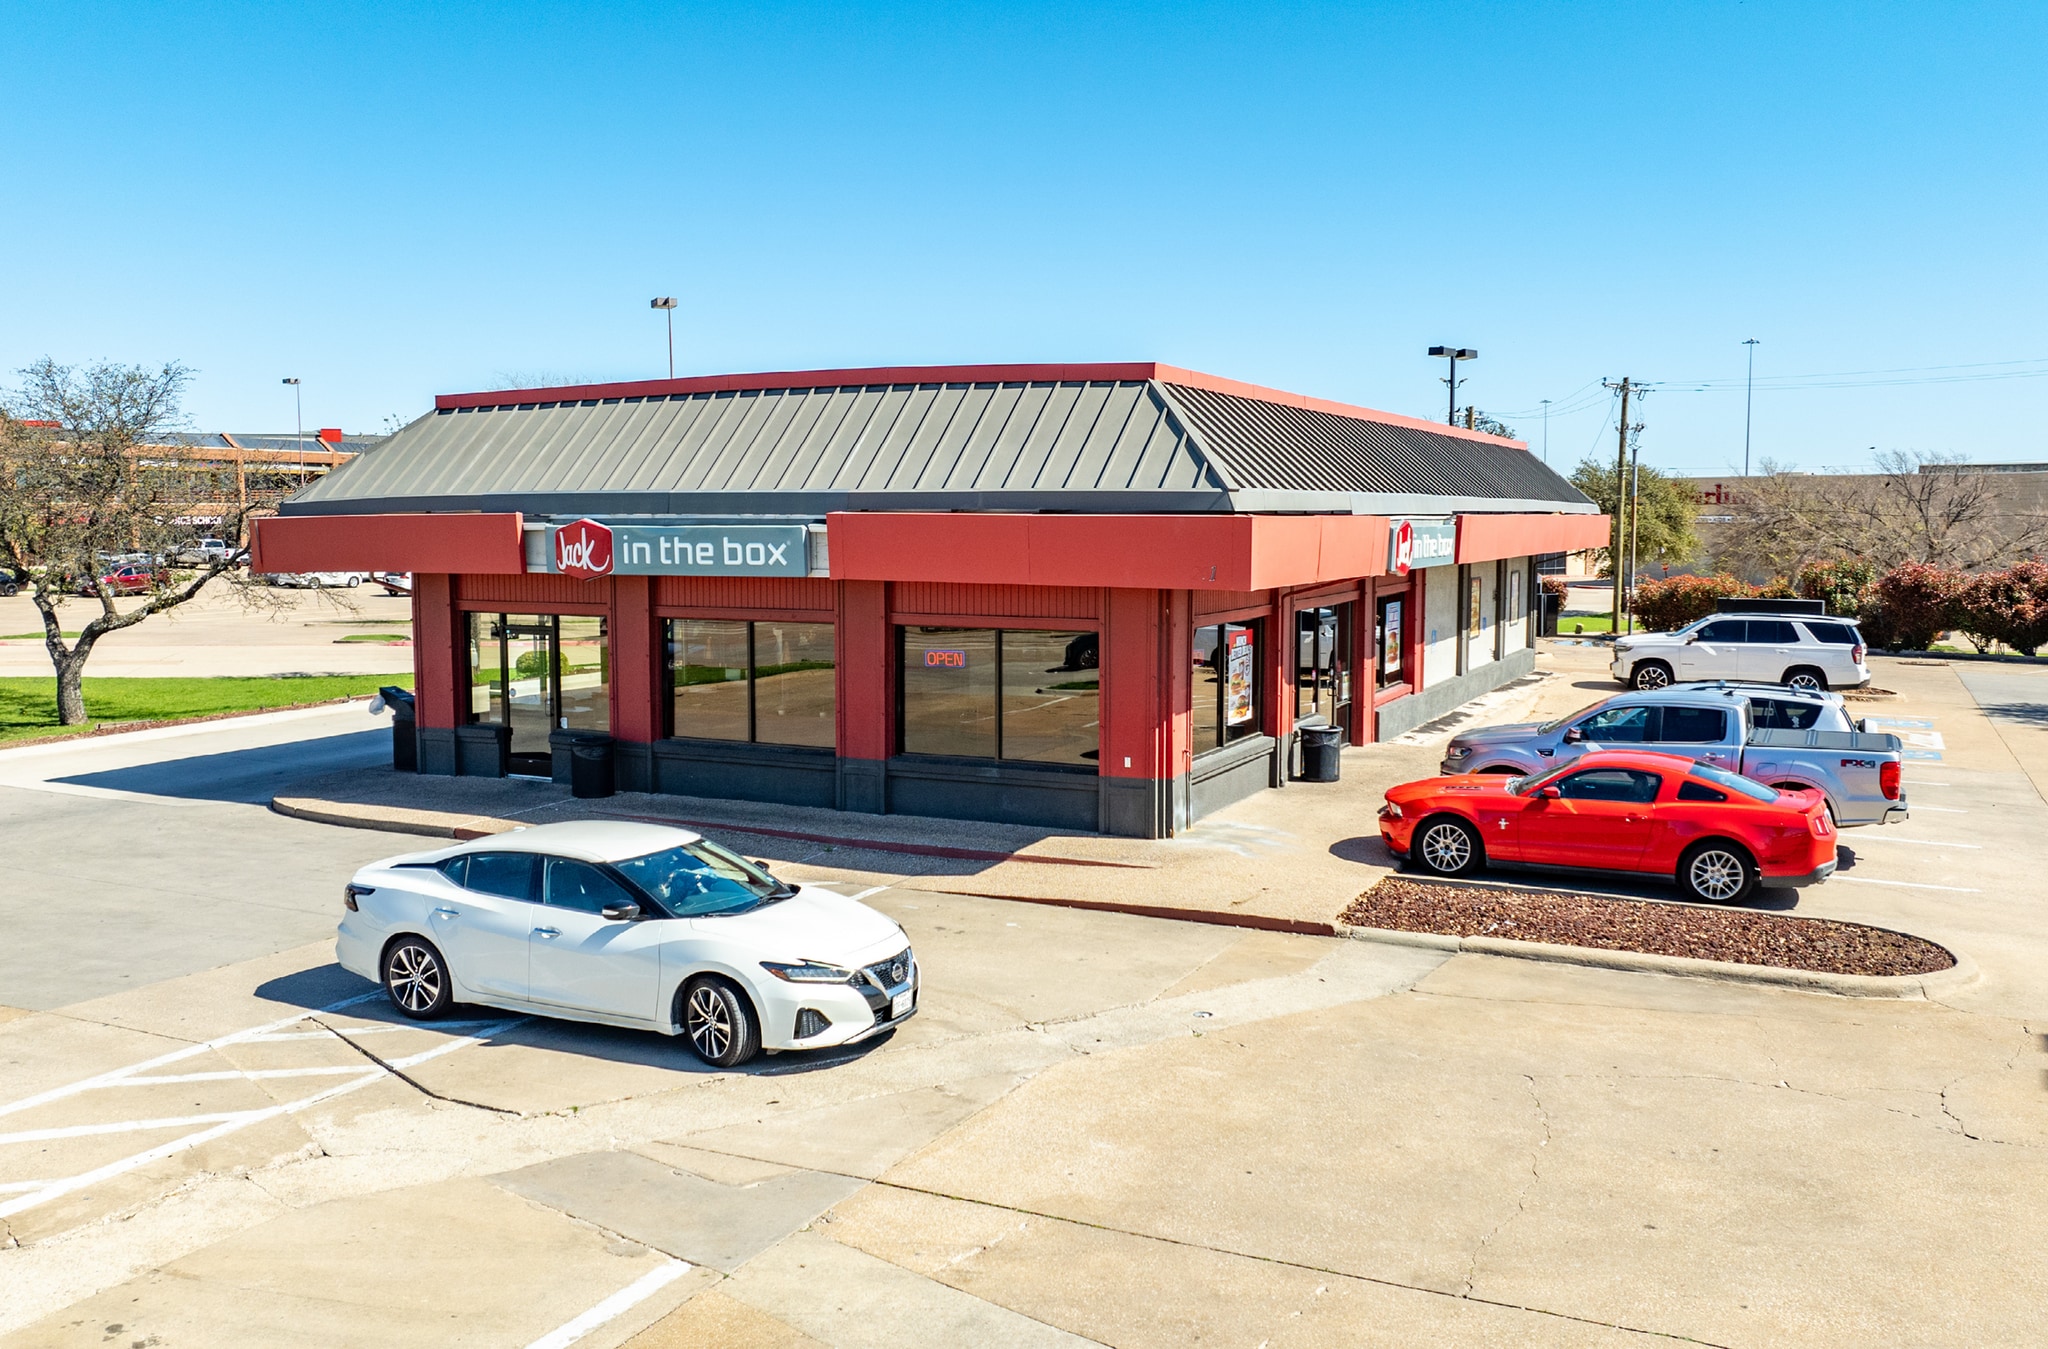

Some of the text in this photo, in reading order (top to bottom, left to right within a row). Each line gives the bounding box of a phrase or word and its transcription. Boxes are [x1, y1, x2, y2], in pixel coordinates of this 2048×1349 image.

[557, 527, 787, 572] Jack in the box
[1413, 533, 1422, 559] in
[1423, 534, 1438, 558] the
[1438, 533, 1453, 557] box
[927, 651, 963, 667] OPEN
[1840, 758, 1876, 769] FX4
